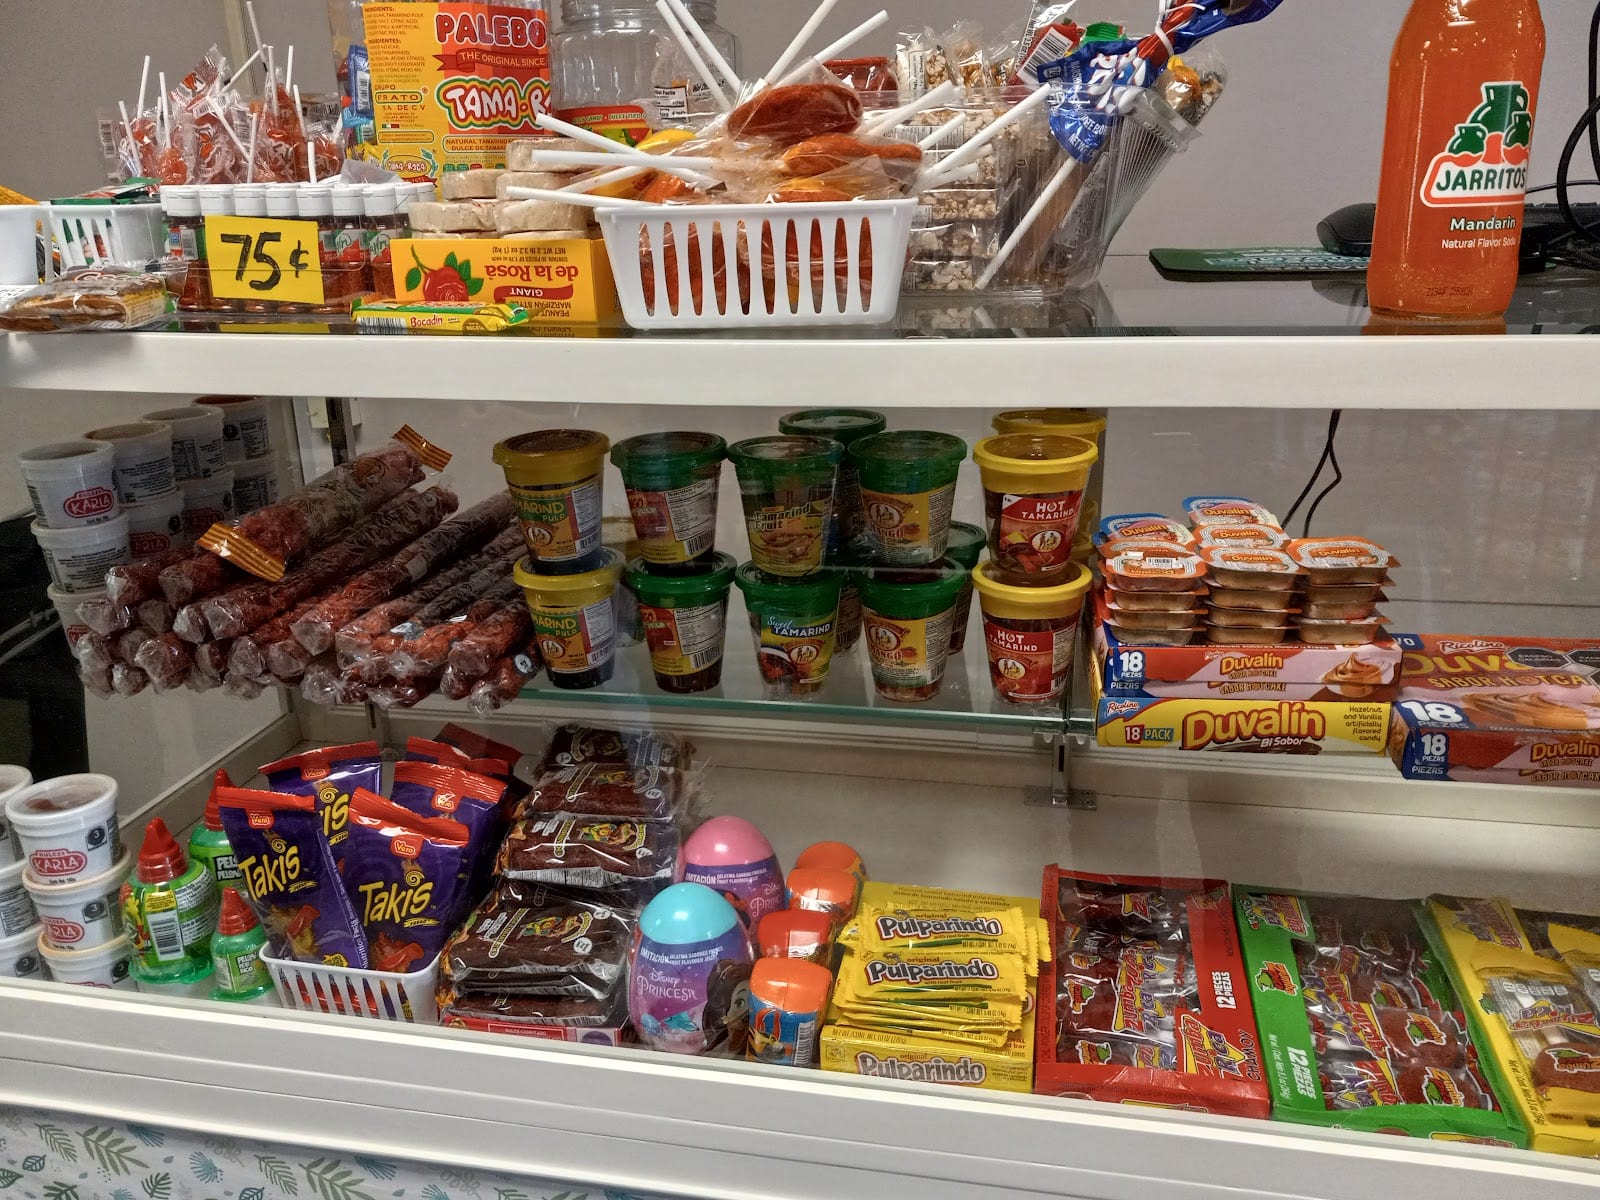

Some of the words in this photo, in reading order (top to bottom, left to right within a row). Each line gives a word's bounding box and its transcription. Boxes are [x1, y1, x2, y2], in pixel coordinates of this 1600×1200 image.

[434, 12, 547, 49] PALEBO
[460, 51, 481, 61] THE
[482, 54, 521, 66] ORIGINAL
[521, 58, 546, 66] SINCE
[1436, 167, 1526, 192] JARRITOS
[1450, 215, 1516, 231] Mandarin
[1441, 238, 1476, 249] Natural
[1477, 238, 1501, 248] Flavor
[485, 265, 532, 281] Rosa
[534, 265, 553, 281] la
[555, 265, 579, 281] de
[509, 287, 544, 297] GIANT
[534, 301, 572, 309] MARZIPAN
[540, 309, 570, 317] PEANUT
[71, 494, 112, 514] KARLA
[1036, 501, 1066, 512] HOT
[1021, 508, 1074, 520] TAMARIND
[768, 615, 793, 629] Sweet
[775, 624, 831, 637] TAMARIND
[997, 630, 1025, 644] HOT
[989, 635, 1038, 652] TAMARIND
[1120, 651, 1143, 672] 18
[1110, 682, 1140, 690] PIEZAS
[1429, 676, 1496, 688] SABOR
[1106, 699, 1140, 714] Ricolino
[1349, 705, 1382, 713] Hazelnut
[1401, 701, 1463, 723] 18
[1345, 720, 1382, 729] artificially
[1352, 727, 1382, 735] flavored
[1417, 721, 1470, 729] PIEZAS
[1126, 726, 1140, 741] 18
[1144, 728, 1171, 741] PACK
[1421, 733, 1447, 756] 18
[1422, 755, 1445, 763] PIEZAS
[1412, 765, 1444, 775] PIEZAS
[251, 814, 270, 826] Vero
[94, 830, 100, 838] 3
[394, 841, 416, 855] Vero
[34, 856, 80, 873] KARLA
[238, 846, 300, 902] Takis
[685, 872, 716, 885] IMITACIÓN
[91, 904, 97, 912] 3
[358, 879, 434, 926] Takis
[878, 917, 1003, 940] Pulparindo
[640, 945, 670, 964] IMITACIÓN
[906, 956, 940, 964] original
[649, 968, 680, 988] Disney
[865, 958, 999, 986] Pulparindo
[1212, 971, 1223, 996] PIECES
[1222, 971, 1234, 997] PIEZAS
[1120, 985, 1143, 1032] Zumba
[1216, 995, 1236, 1009] 12
[1183, 1016, 1214, 1076] Zumba
[1207, 1030, 1240, 1076] Rica
[899, 1052, 928, 1061] original
[1240, 1029, 1261, 1081] CHAMOY
[856, 1052, 987, 1085] Pulparindo
[1286, 1044, 1309, 1070] 12
[1300, 1066, 1317, 1100] PIECES
[1290, 1064, 1307, 1097] PIEZAS
